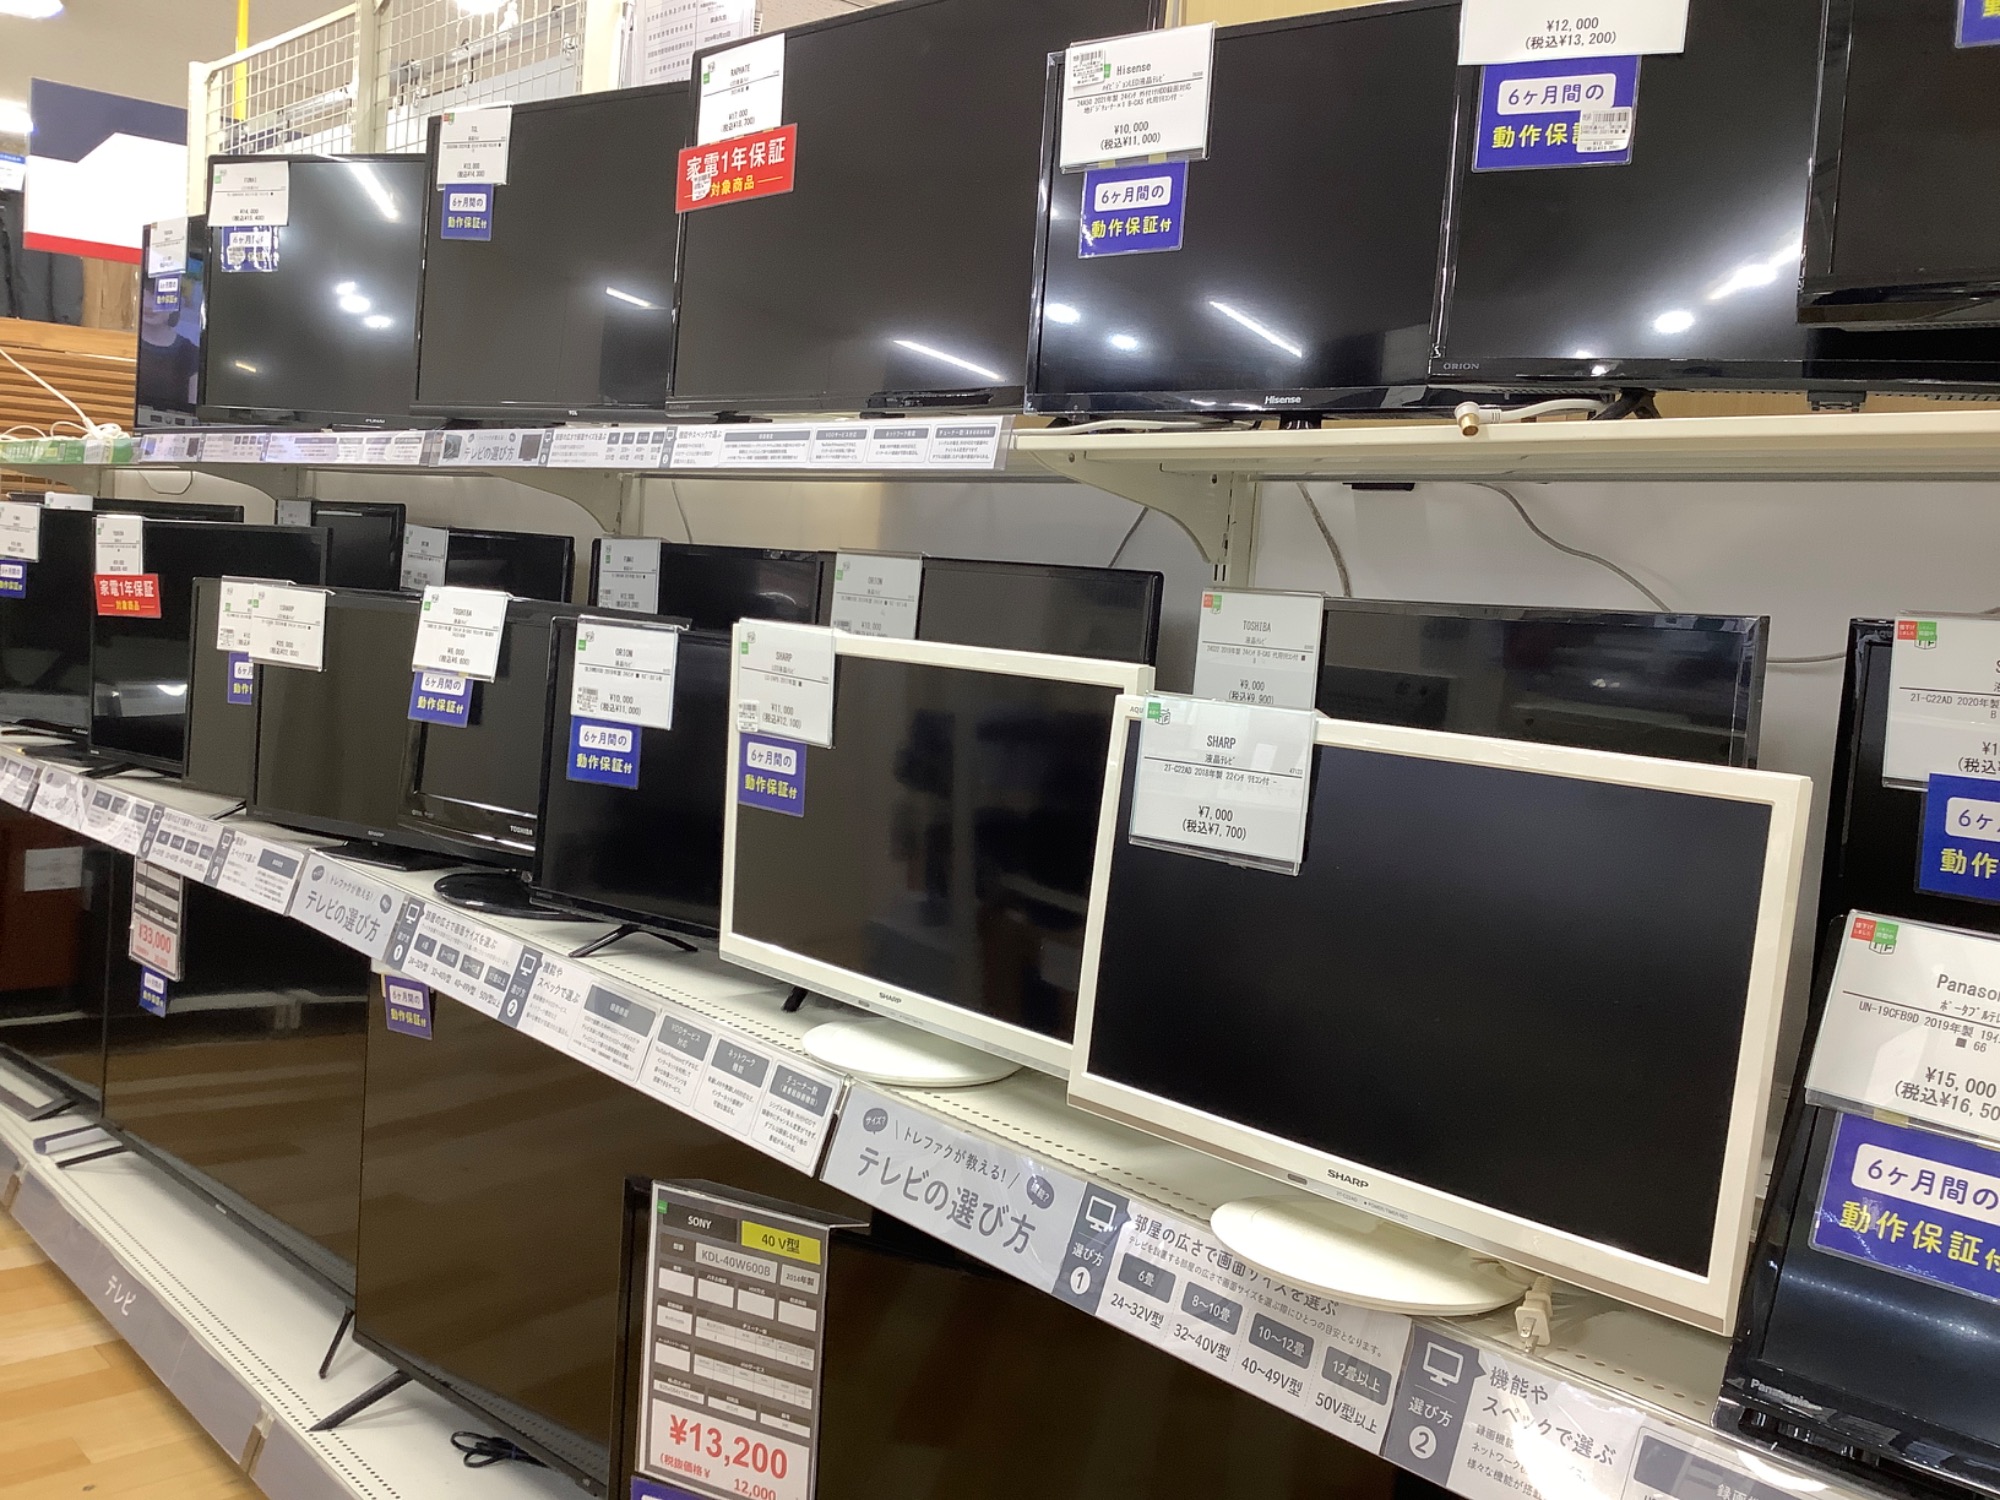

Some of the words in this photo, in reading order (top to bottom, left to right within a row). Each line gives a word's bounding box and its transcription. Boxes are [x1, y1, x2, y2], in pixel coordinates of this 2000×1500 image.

[1546, 17, 1599, 32] ¥12,000
[1525, 31, 1617, 50] (税込¥13,200)
[1117, 63, 1151, 76] Hisense
[1114, 121, 1149, 136] ¥10,000
[1492, 123, 1580, 149] 動作保
[1100, 133, 1161, 150] (税込¥11,000)
[686, 137, 787, 181] 家電1年保証
[710, 175, 755, 197] 対象商品
[1091, 217, 1172, 238] 動作保証付
[1443, 362, 1480, 370] ORION
[1265, 395, 1302, 405] Hisense
[99, 580, 155, 597] 家電1年保証
[1243, 620, 1271, 632] TOSHIBA
[417, 696, 464, 715] 動作保証付
[1206, 735, 1236, 749] SHARP
[576, 755, 633, 774] 動作保証付
[1958, 756, 2000, 774] (税込
[744, 774, 798, 800] 動作保証付
[1199, 805, 1233, 822] ¥7,000
[1958, 809, 2000, 832] 6ヶ
[1182, 818, 1247, 841] (税込¥7,700)
[305, 890, 381, 942] テレビの選び方
[1859, 1001, 1920, 1024] UN-19CFB9D
[1924, 1017, 1974, 1038] 2019年製
[1924, 1067, 1997, 1099] ¥15,000
[1327, 1169, 1369, 1189] SHARP
[857, 1146, 1036, 1254] テレビの選び方
[687, 1215, 712, 1230] SONY
[762, 1234, 775, 1246] 40
[778, 1237, 800, 1254] V型
[702, 1250, 771, 1277] KDL-40W600B
[1071, 1242, 1104, 1267] 選び方
[1137, 1271, 1155, 1288] 6畳
[1331, 1360, 1381, 1394] 12畳以上
[1489, 1366, 1549, 1405] 機能や
[1315, 1392, 1378, 1435] 50V型以上
[1408, 1396, 1453, 1428] 選び方
[669, 1414, 788, 1479] ¥13,200
